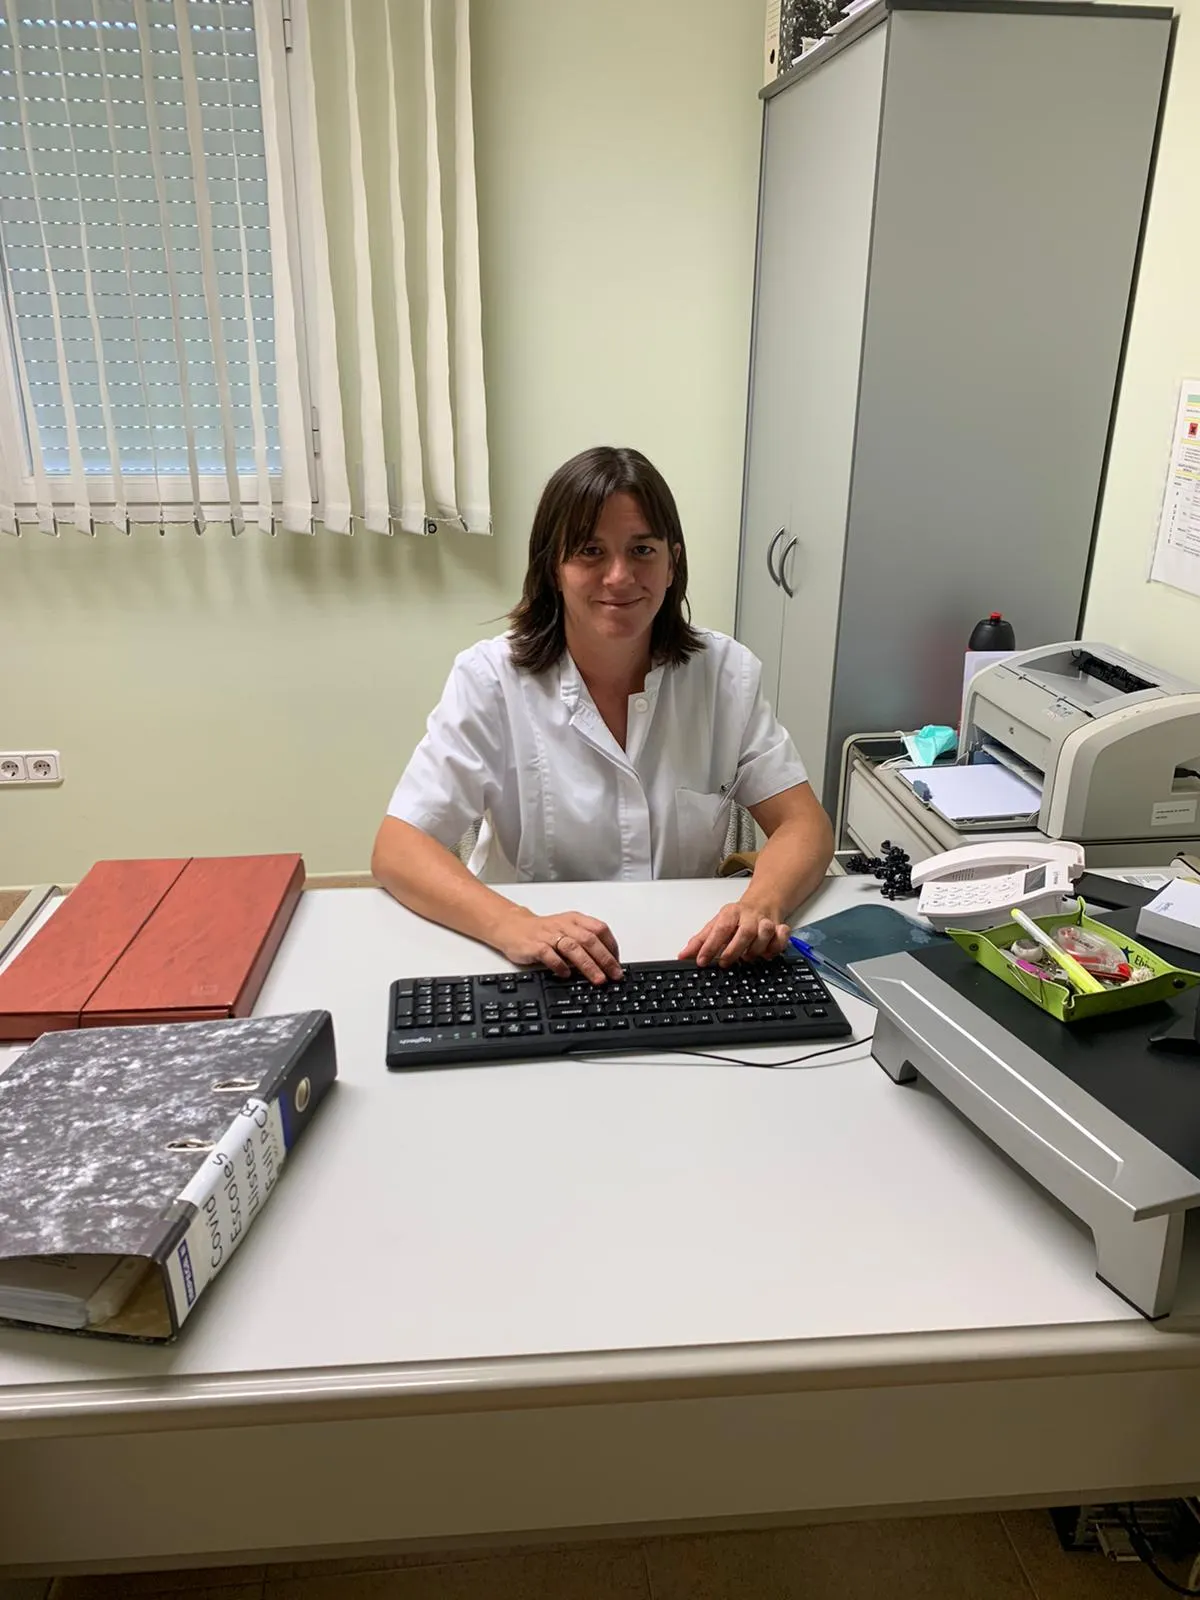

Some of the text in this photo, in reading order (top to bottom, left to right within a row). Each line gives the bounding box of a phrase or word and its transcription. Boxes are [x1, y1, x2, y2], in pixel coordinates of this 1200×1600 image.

[240, 1103, 269, 1144] PCR
[202, 1194, 223, 1268] Covid
[212, 1152, 242, 1242] Escoles
